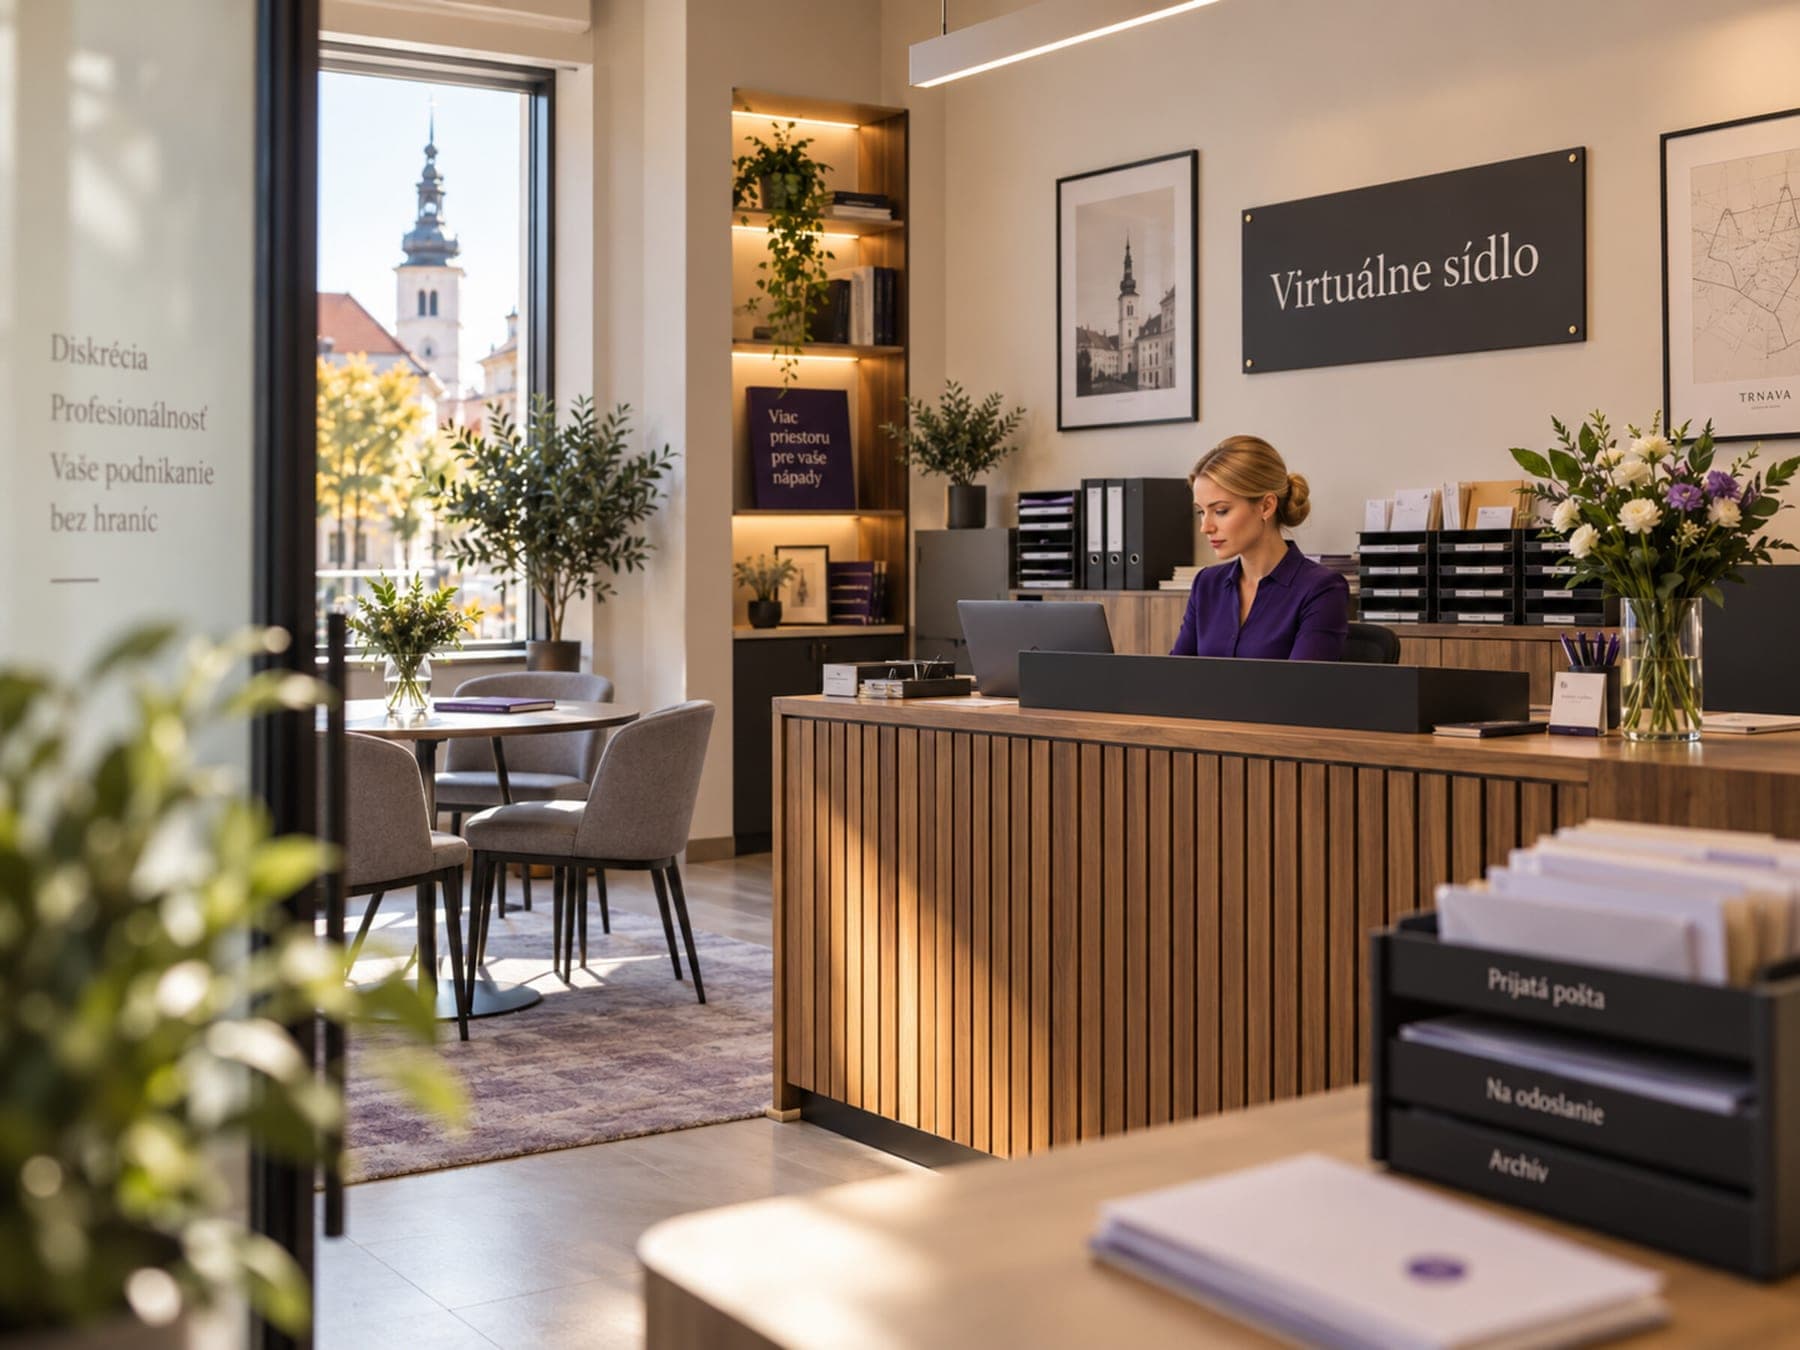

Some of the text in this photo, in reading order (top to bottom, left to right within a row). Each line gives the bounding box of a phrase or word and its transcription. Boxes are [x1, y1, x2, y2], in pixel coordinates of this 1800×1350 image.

[1270, 232, 1540, 311] Virtuálne sídlo
[50, 333, 149, 371] Diskrécia
[50, 393, 208, 431] Profesionálnosť
[1739, 390, 1792, 402] TRNAVA
[768, 409, 799, 424] Viac
[770, 429, 830, 447] priestoru
[50, 451, 215, 490] Vaše podnikanie
[771, 450, 828, 467] pre vaše
[773, 469, 822, 488] nápady
[50, 502, 158, 532] bez hraníc
[1488, 967, 1605, 1010] Prijatá pošta
[1486, 1078, 1605, 1126] Na odoslanie
[1489, 1149, 1550, 1184] Archív
